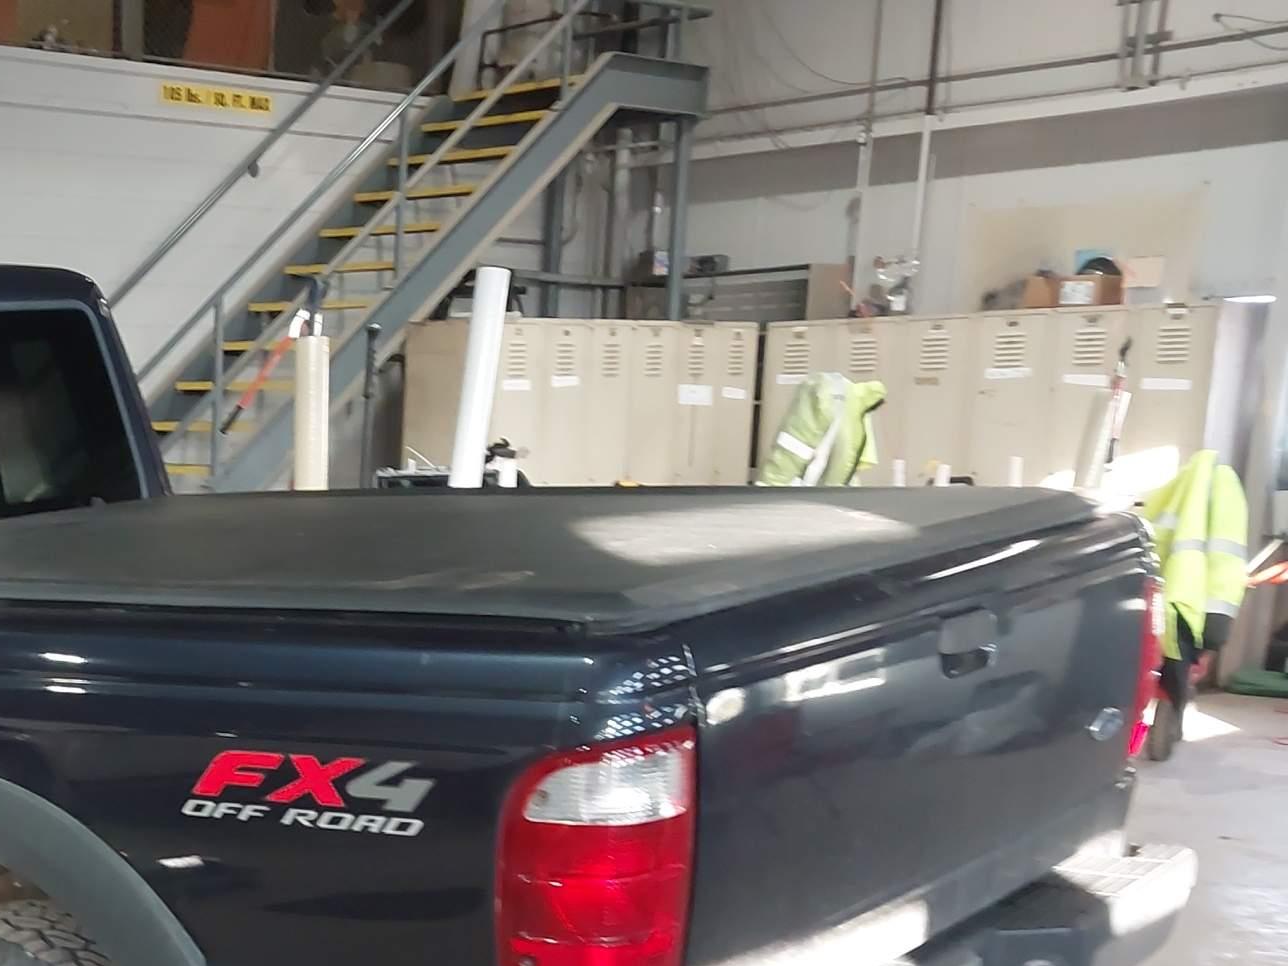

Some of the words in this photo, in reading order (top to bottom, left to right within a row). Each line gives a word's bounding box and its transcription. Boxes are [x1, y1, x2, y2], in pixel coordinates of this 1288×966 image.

[191, 749, 436, 812] FX4
[181, 799, 272, 821] OFF
[280, 808, 424, 837] ROAD
